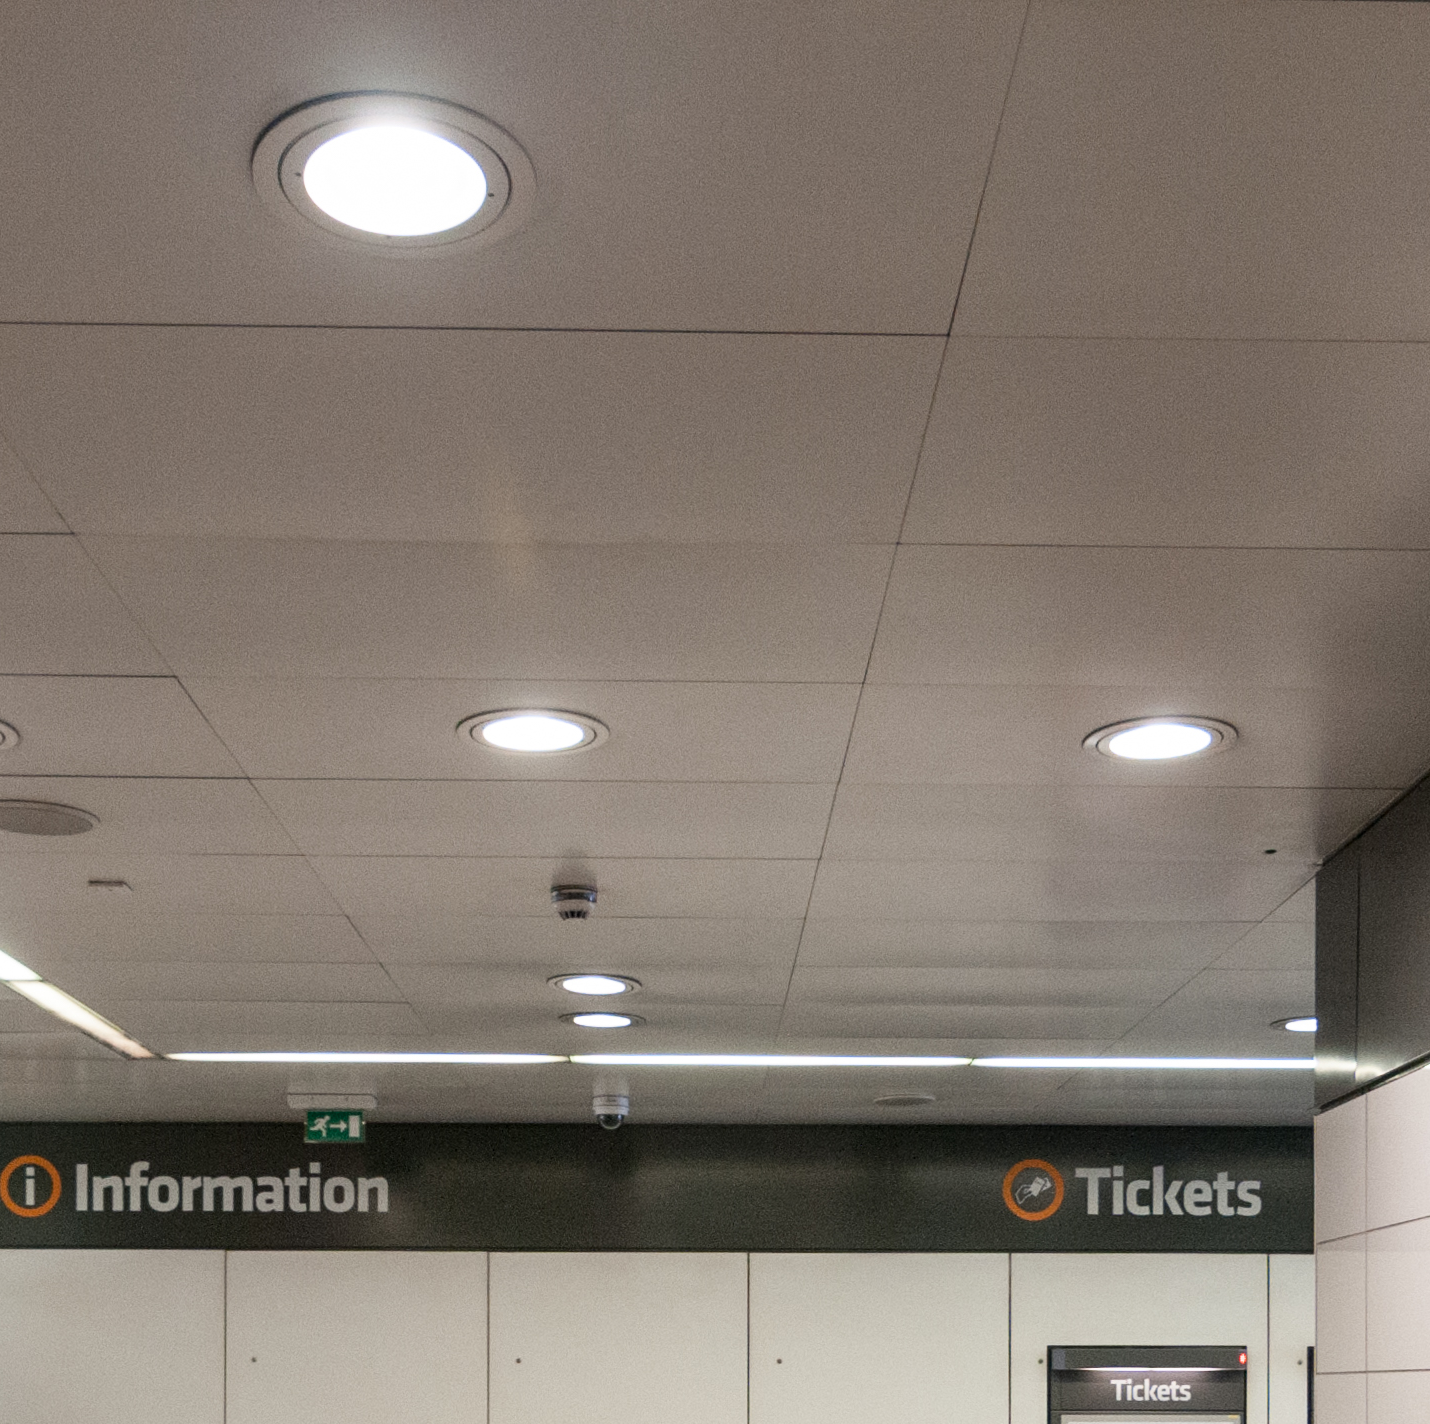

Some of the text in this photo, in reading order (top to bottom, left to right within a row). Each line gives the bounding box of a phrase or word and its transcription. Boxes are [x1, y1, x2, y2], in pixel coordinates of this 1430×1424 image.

[76, 1161, 389, 1213] Information
[1075, 1165, 1262, 1217] Tickets
[1110, 1378, 1192, 1402] Tickets
